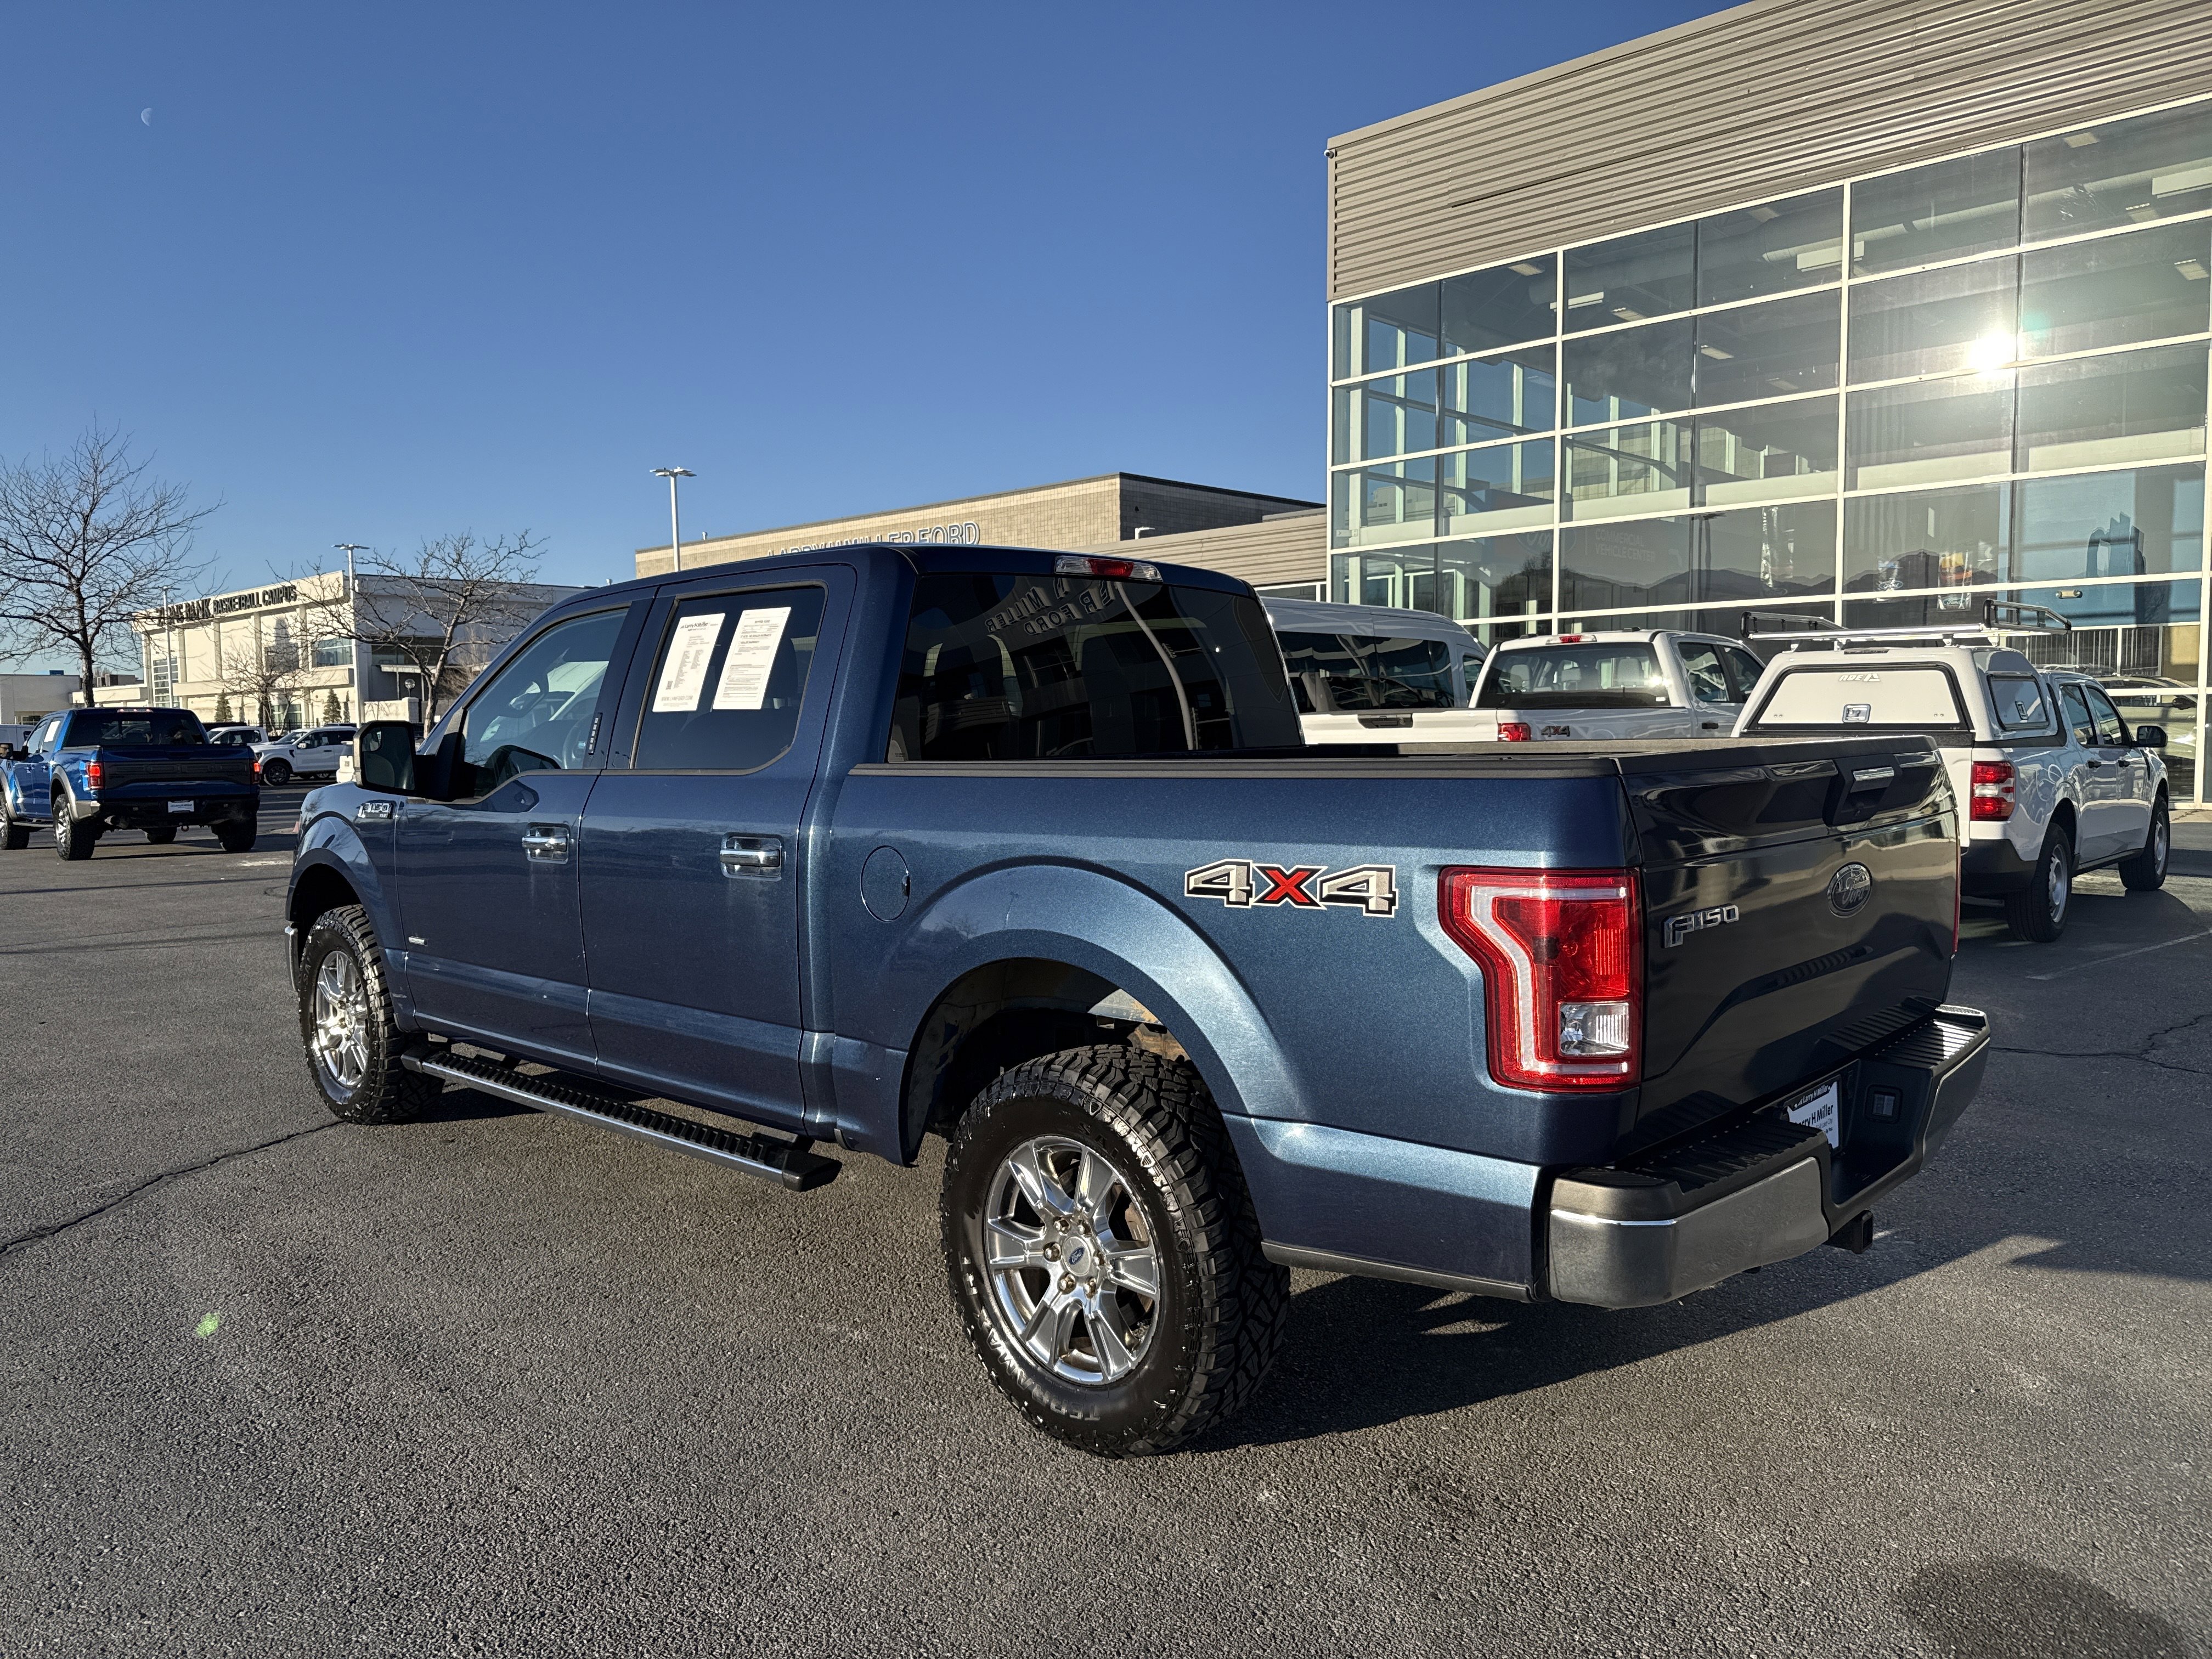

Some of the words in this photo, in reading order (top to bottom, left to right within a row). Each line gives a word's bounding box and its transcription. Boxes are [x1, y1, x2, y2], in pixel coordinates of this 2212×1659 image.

[1595, 528, 1645, 547] COMMERCIAL
[1595, 543, 1628, 558] VEHICLE
[1628, 547, 1656, 563] CENTER
[213, 591, 262, 615] BASKETBALL
[262, 585, 297, 606] CAMPUS
[1812, 1111, 1816, 1125] H
[1817, 1103, 1833, 1122] Miller
[1071, 1249, 1082, 1263] Ford
